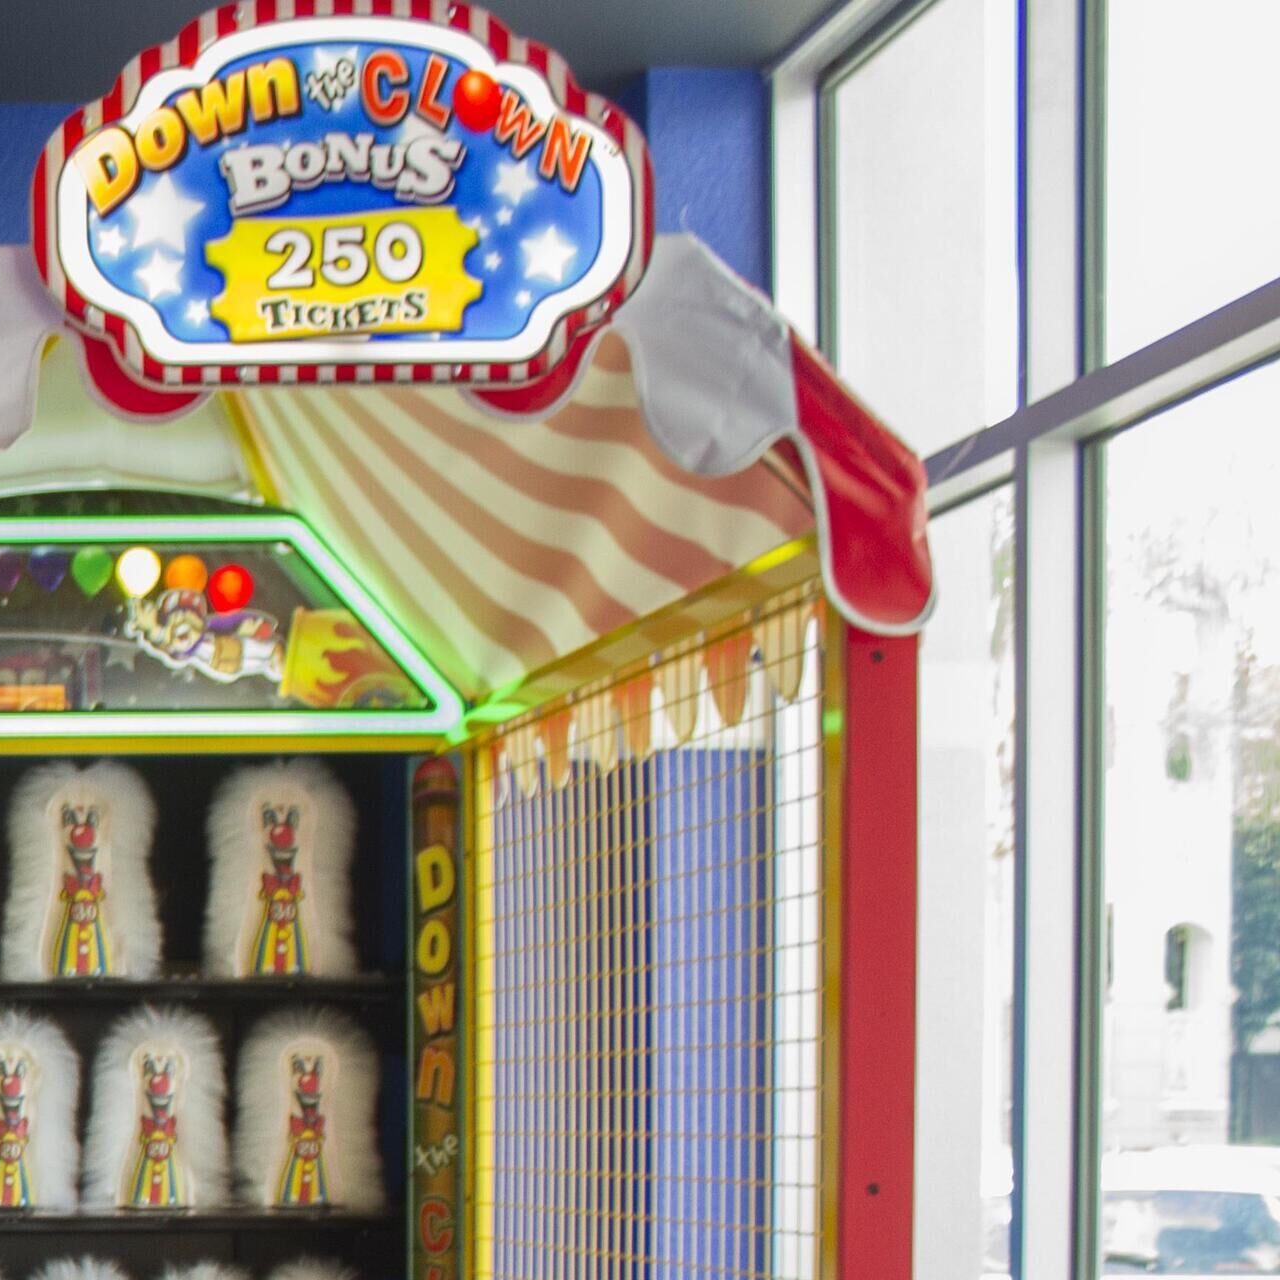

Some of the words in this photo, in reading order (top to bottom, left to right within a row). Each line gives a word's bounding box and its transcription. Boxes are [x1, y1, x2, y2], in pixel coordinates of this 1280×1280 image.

[306, 60, 358, 111] the
[361, 48, 592, 193] CLOWN
[264, 222, 424, 291] 250
[70, 901, 98, 923] 30
[0, 1141, 23, 1160] 20
[147, 1141, 171, 1160] 20
[414, 1132, 459, 1177] the
